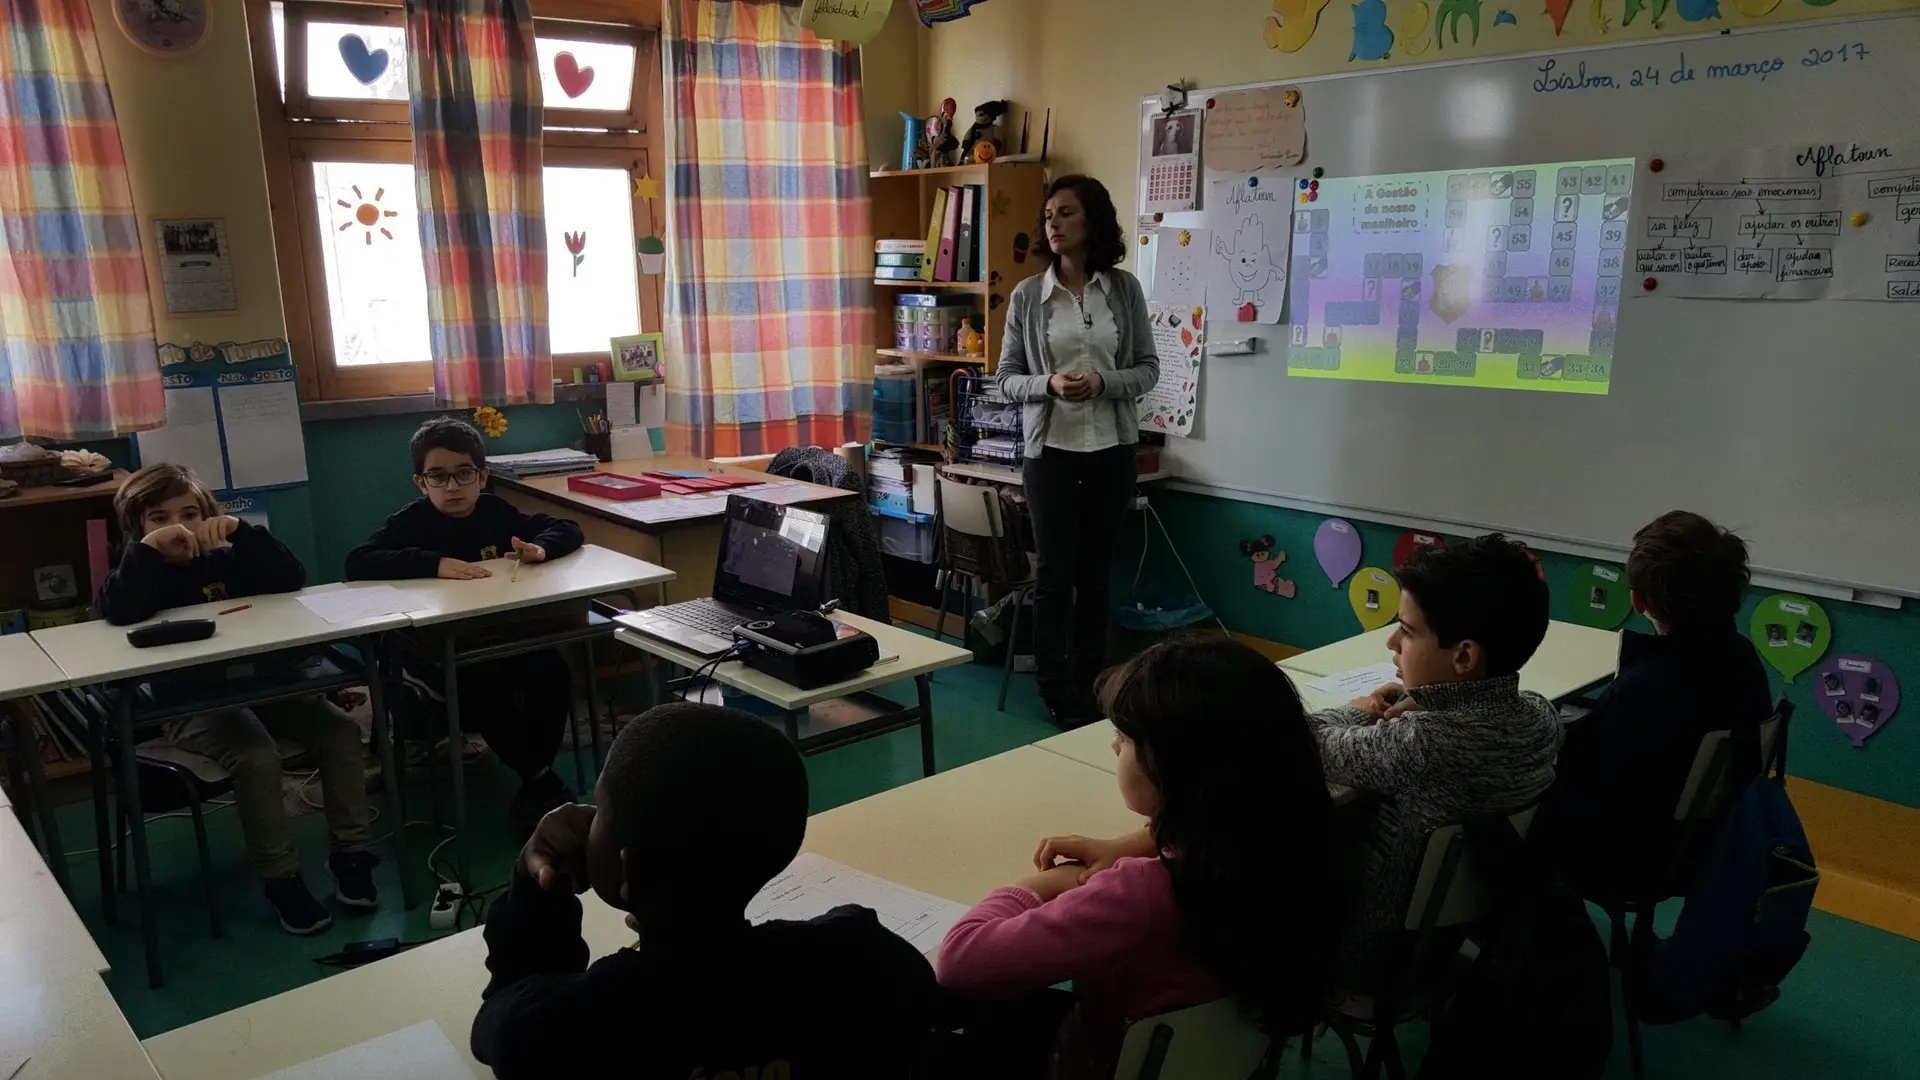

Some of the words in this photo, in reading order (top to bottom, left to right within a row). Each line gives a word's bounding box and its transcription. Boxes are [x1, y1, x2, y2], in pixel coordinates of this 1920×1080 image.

[1630, 68, 1660, 87] 24
[1669, 51, 1695, 85] de
[1706, 56, 1785, 82] março
[1802, 41, 1872, 67] 2017
[1515, 179, 1532, 191] 55
[1560, 176, 1577, 188] 43
[1585, 175, 1602, 187] 42
[1609, 173, 1626, 186] 41
[1364, 188, 1374, 200] A
[1513, 206, 1530, 218] 54
[1360, 217, 1419, 230] mealheiro
[1672, 215, 1700, 238] feliz
[1790, 216, 1802, 229] os
[1804, 212, 1839, 230] outros
[1511, 233, 1528, 245] 53
[1556, 230, 1573, 242] 45
[1604, 230, 1622, 242] 39
[1407, 261, 1419, 271] 19
[1554, 257, 1571, 268] 46
[1603, 257, 1620, 268] 38
[1506, 285, 1522, 296] 49
[1552, 284, 1568, 296] 47
[160, 346, 184, 364] rio
[219, 339, 284, 362] Turma
[1568, 363, 1583, 374] 33
[1590, 363, 1605, 375] 34
[162, 373, 192, 385] osto
[255, 368, 293, 384] gosto
[223, 496, 253, 510] onho
